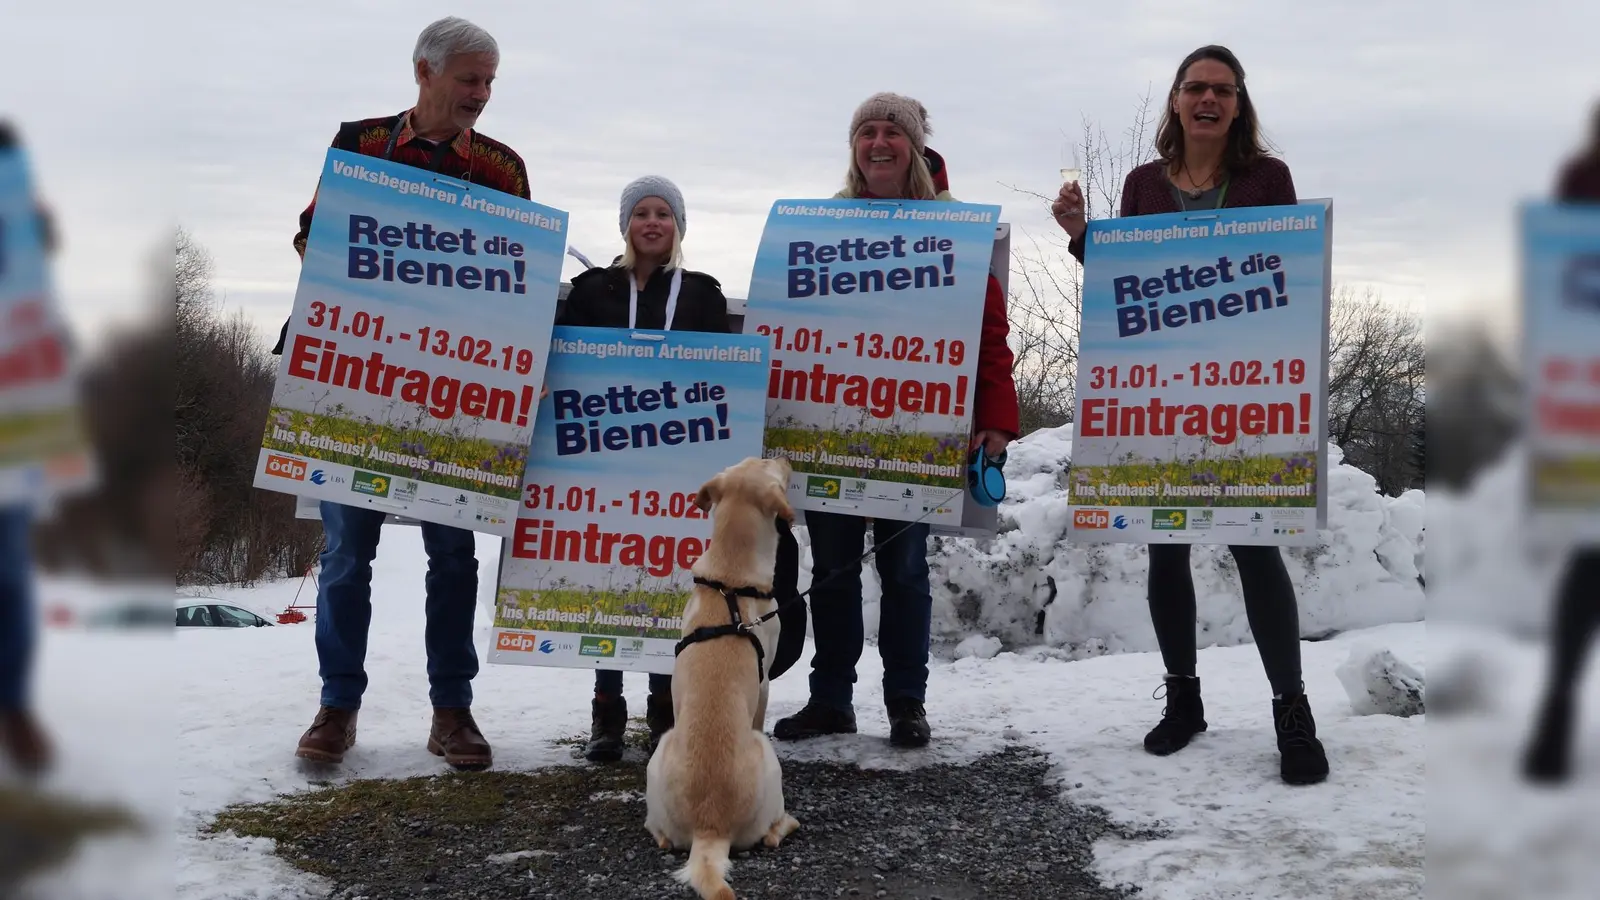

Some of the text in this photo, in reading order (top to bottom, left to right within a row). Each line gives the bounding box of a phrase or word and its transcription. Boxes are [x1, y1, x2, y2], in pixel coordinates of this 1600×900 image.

[332, 160, 562, 232] Volksbegehren Artenvielfalt
[776, 205, 992, 223] Volksbegehren Artenvielfalt
[349, 214, 524, 257] Rettet die
[788, 235, 953, 266] Rettet die
[1092, 215, 1318, 245] Volksbegehren Artenvielfalt
[348, 247, 526, 294] Bienen!
[787, 254, 956, 299] Bienen!
[1113, 252, 1282, 305] Rettet die
[1117, 271, 1289, 338] Bienen!
[552, 339, 762, 363] lksbegehren Artenvielfalt
[288, 335, 534, 427] Eintragen!
[553, 381, 726, 420] Rettet die
[768, 360, 968, 419] intragen!
[555, 403, 731, 456] Bienen!
[1080, 393, 1311, 445] Eintragen!
[269, 459, 304, 478] ödp
[272, 425, 520, 488] Ins Rathaus! Ausweis mitnehmen!
[819, 451, 875, 469] Ausweis
[878, 458, 960, 478] mitnehmen!
[1075, 482, 1311, 496] Ins Rathaus! Ausweis mitnehmen!
[1076, 512, 1107, 527] ödp
[512, 518, 711, 577] Eintrage
[502, 605, 523, 620] Ins
[527, 607, 590, 624] Rathaus!
[594, 612, 654, 628] Ausweis
[500, 636, 534, 650] ödp
